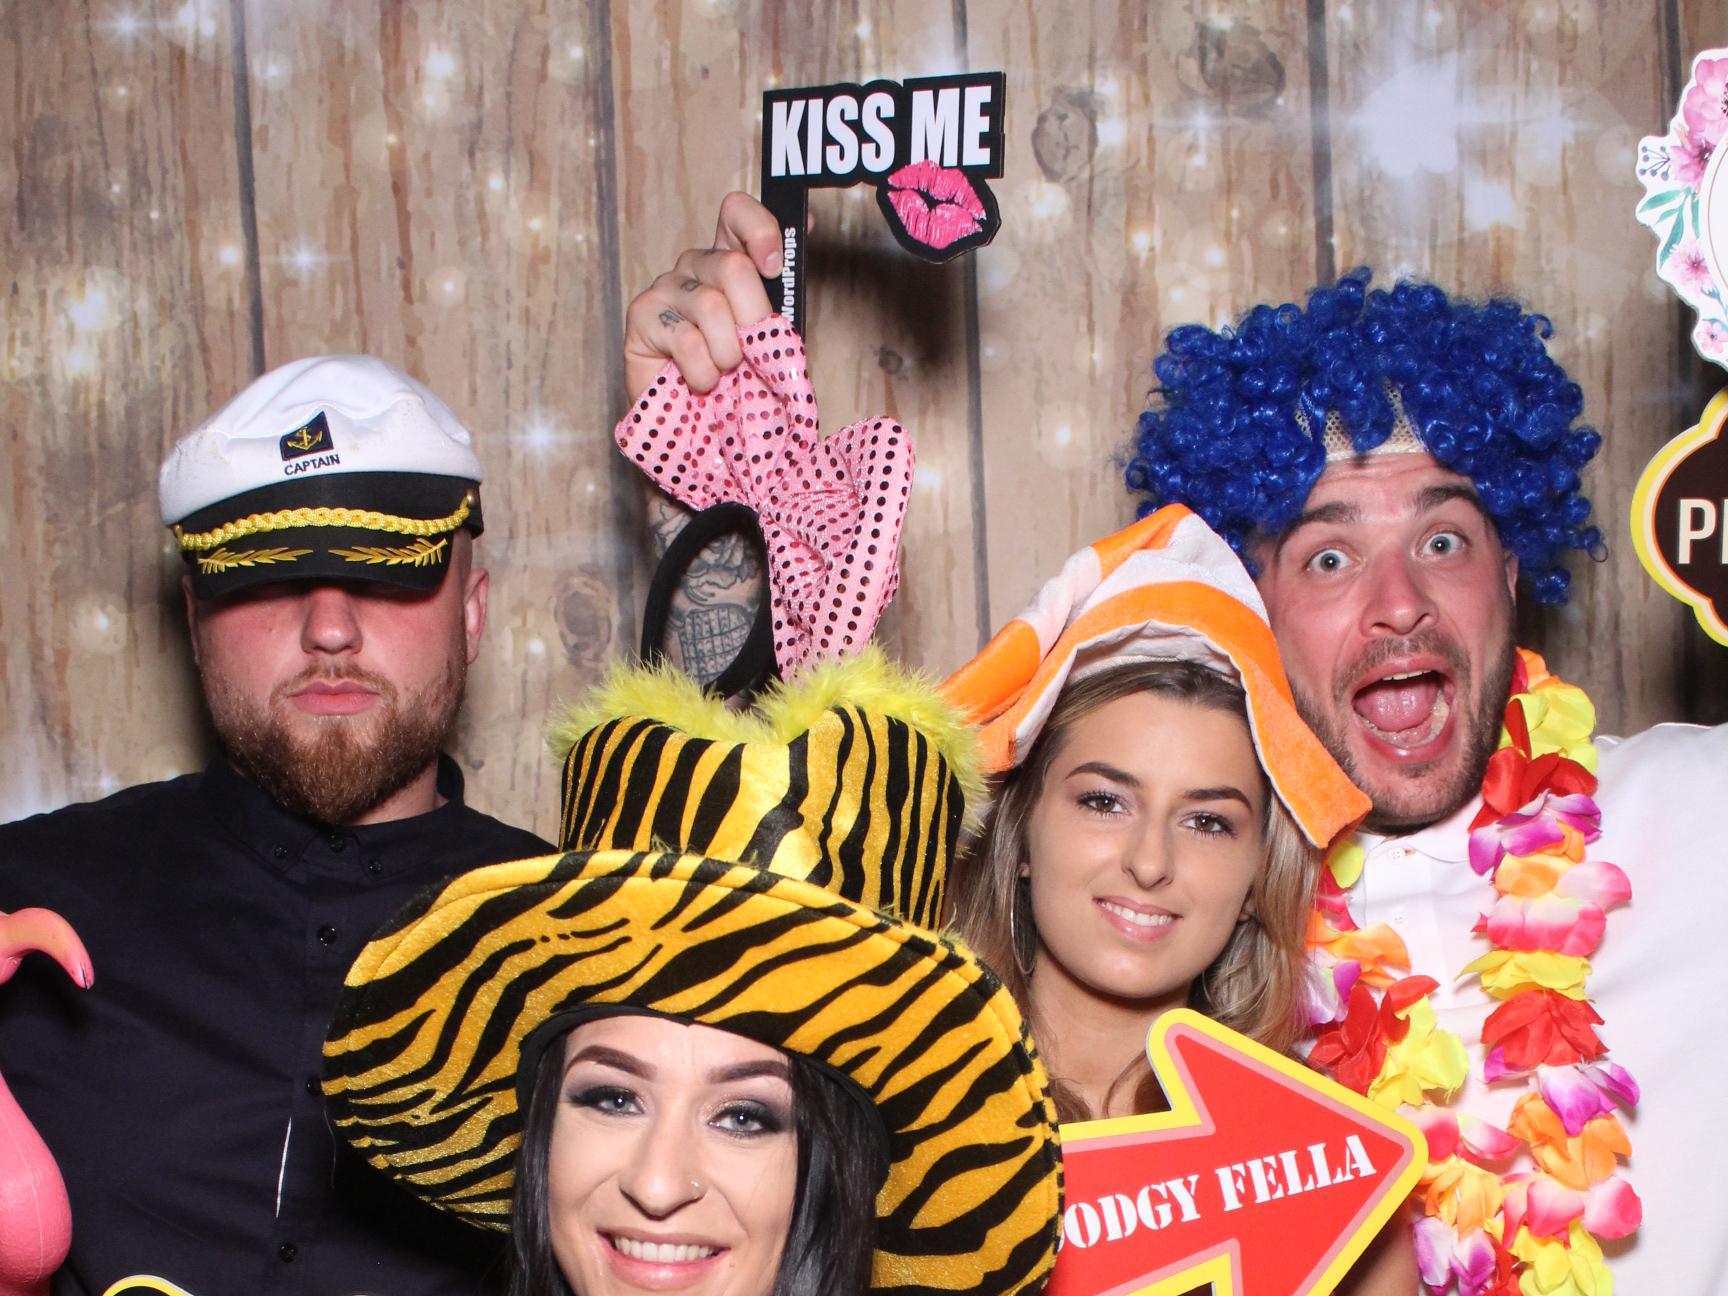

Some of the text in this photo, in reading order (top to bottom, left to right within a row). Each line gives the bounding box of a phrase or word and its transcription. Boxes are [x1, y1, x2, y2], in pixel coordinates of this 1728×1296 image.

[771, 85, 992, 177] KISS ME
[284, 454, 341, 476] CAPTAIN
[1678, 498, 1728, 565] P
[1057, 1134, 1377, 1253] ODGY FELLA
